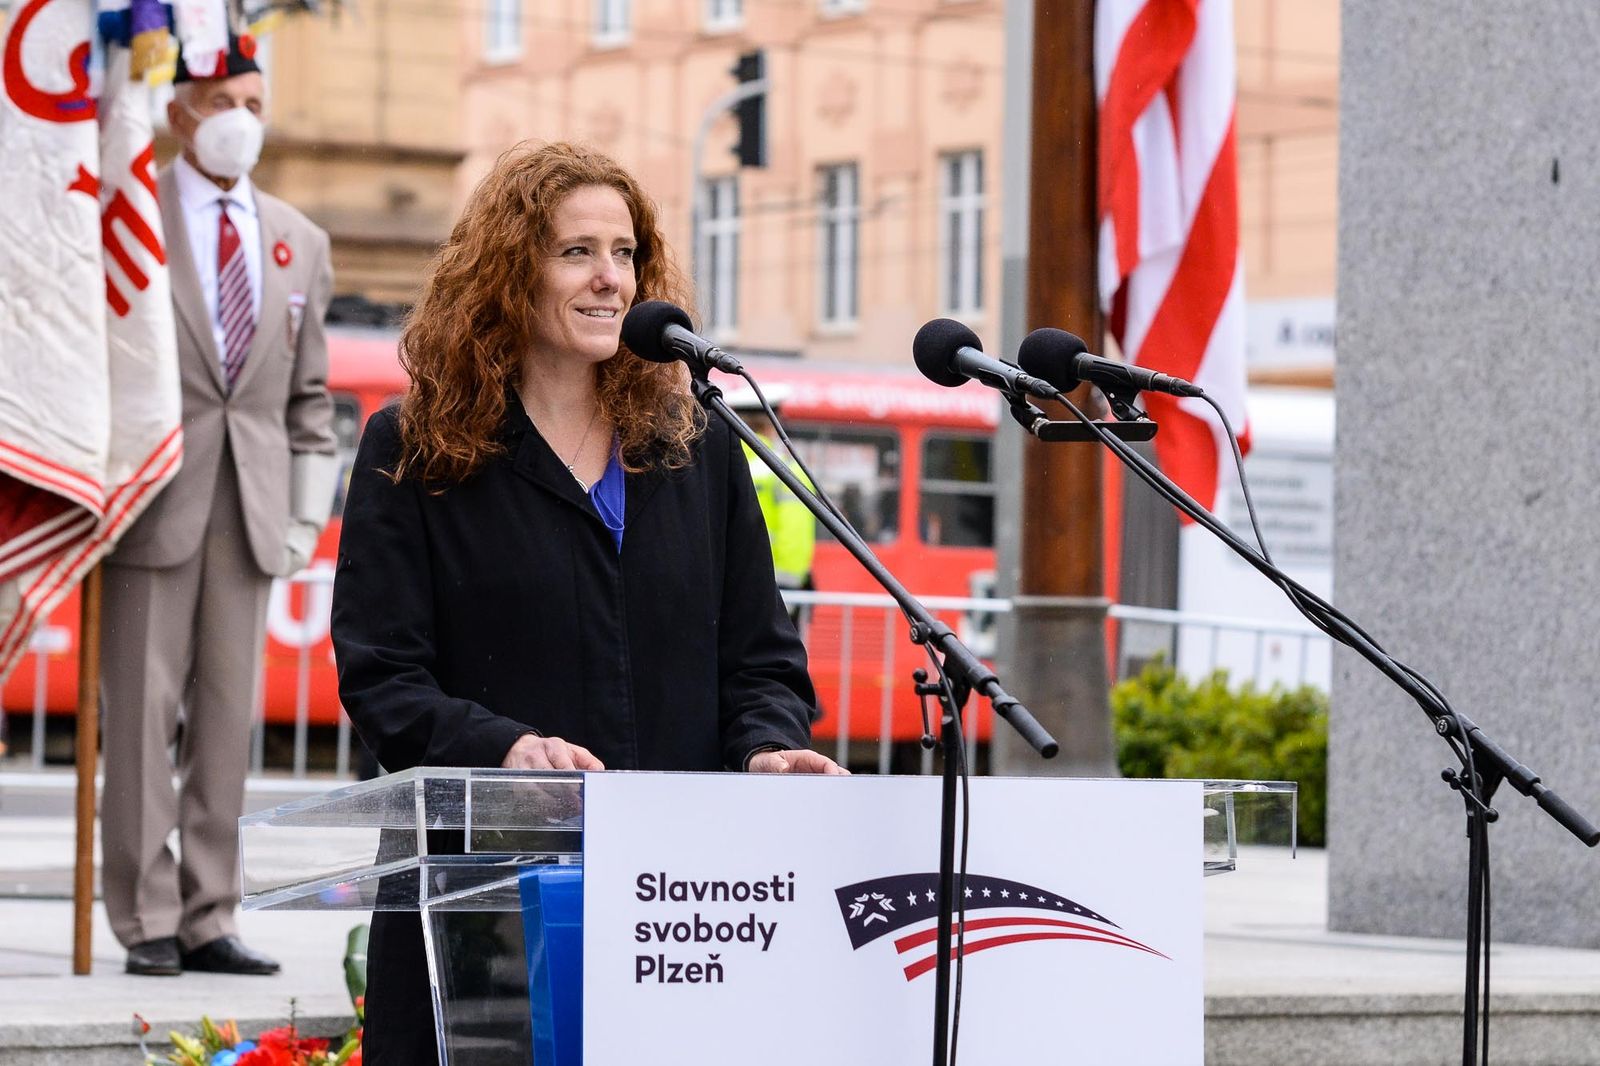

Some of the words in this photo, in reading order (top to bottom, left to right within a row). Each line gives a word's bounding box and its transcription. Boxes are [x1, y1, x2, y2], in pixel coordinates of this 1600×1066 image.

[635, 871, 795, 902] Slavnosti
[634, 913, 778, 951] svobody
[635, 954, 724, 983] Plzeň
